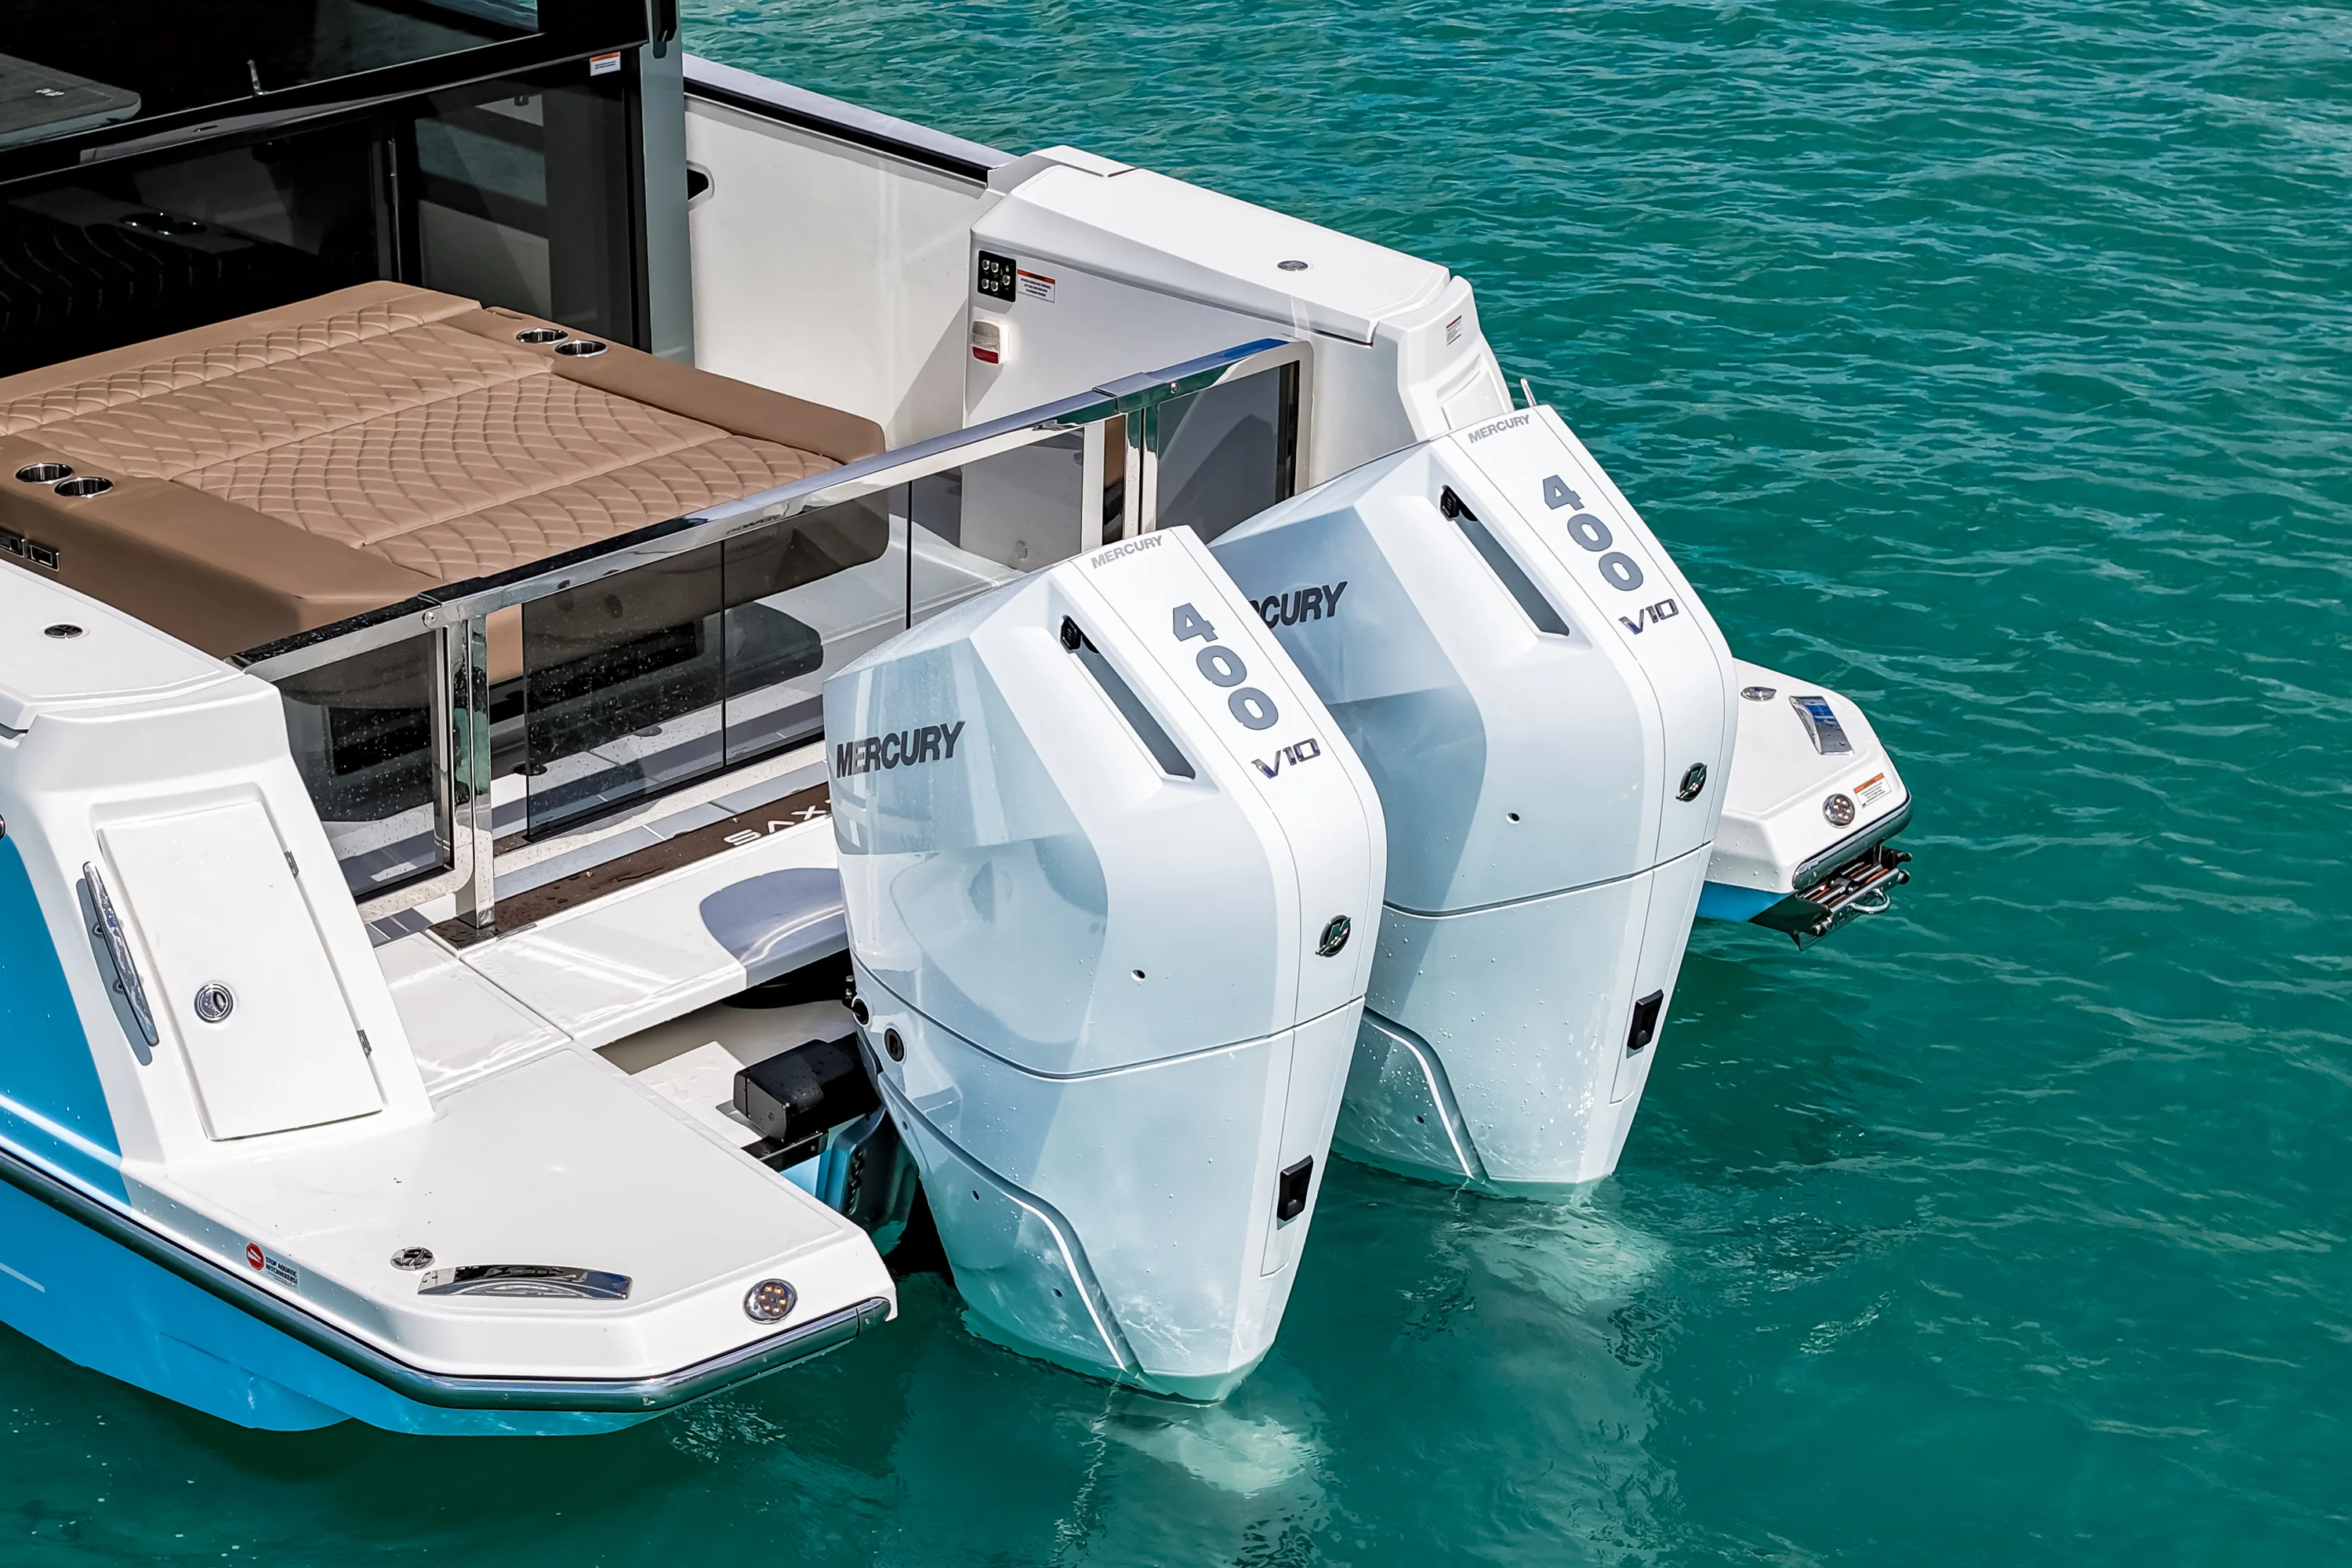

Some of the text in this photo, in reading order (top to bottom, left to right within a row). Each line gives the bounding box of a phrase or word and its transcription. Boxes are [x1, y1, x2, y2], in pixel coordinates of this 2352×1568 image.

[1468, 414, 1530, 444] MERCURY
[1091, 535, 1163, 569] MERCURY
[1543, 474, 1644, 591] 400
[1618, 598, 1679, 635] V10
[1173, 603, 1279, 731] 400
[837, 720, 965, 779] MERCURY
[1250, 738, 1320, 779] V10
[724, 799, 831, 846] SAX
[266, 1256, 297, 1278] STOP AQUATIC
